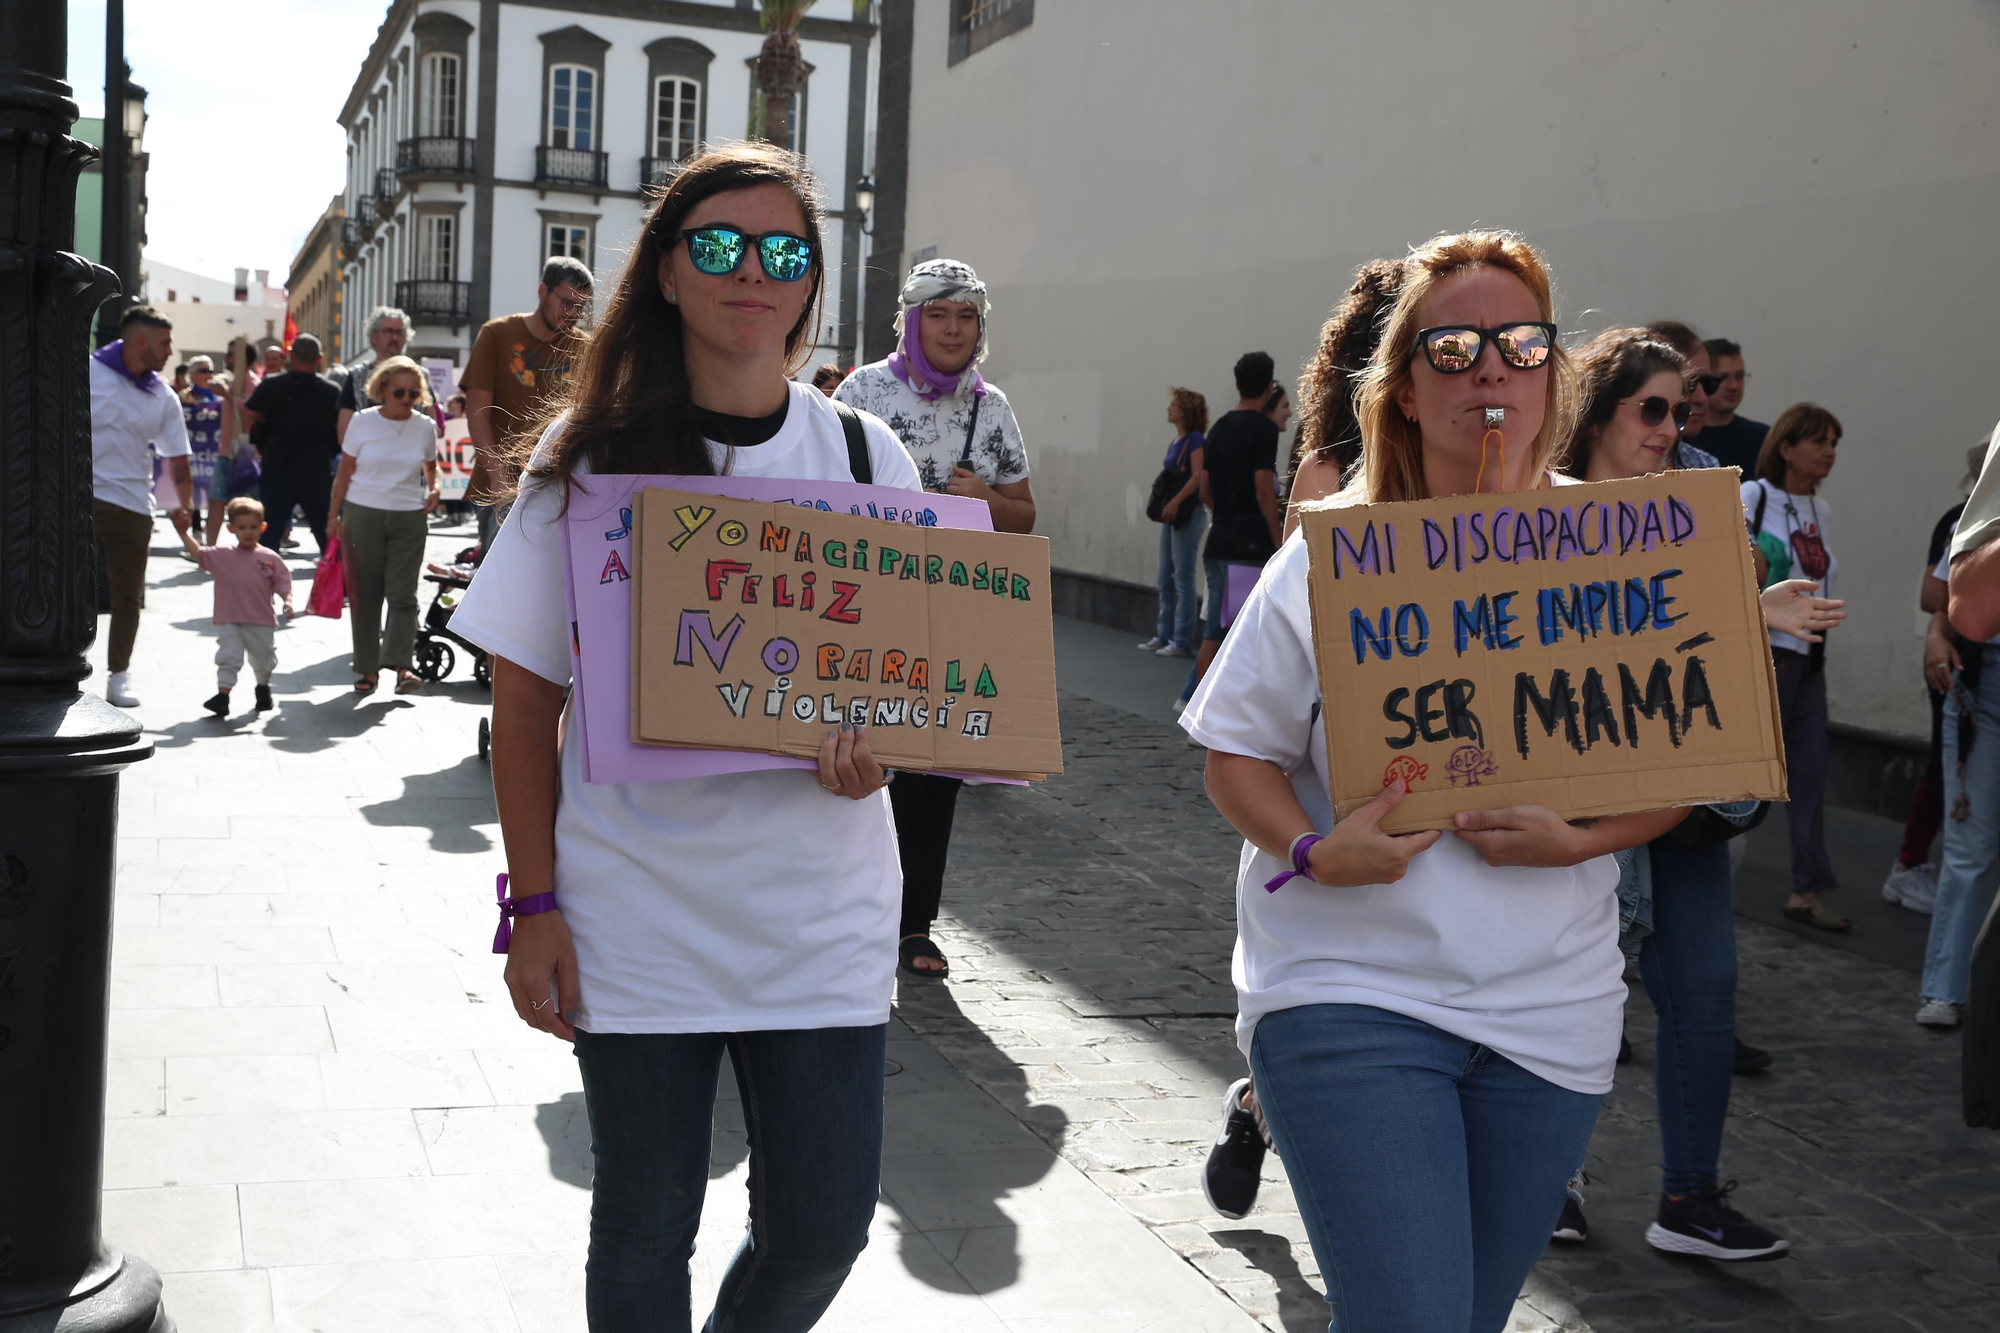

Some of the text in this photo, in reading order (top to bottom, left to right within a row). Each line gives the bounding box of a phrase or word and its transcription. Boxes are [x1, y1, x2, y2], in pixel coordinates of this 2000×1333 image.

[668, 505, 749, 552] YO
[1332, 495, 1696, 580] MI DISCAPACIDAD
[705, 558, 862, 624] FELIZ
[1349, 569, 1689, 664] NO ME IMPIDE
[674, 609, 998, 698] NO PARA LA
[1383, 632, 1723, 760] SER MAMÁ
